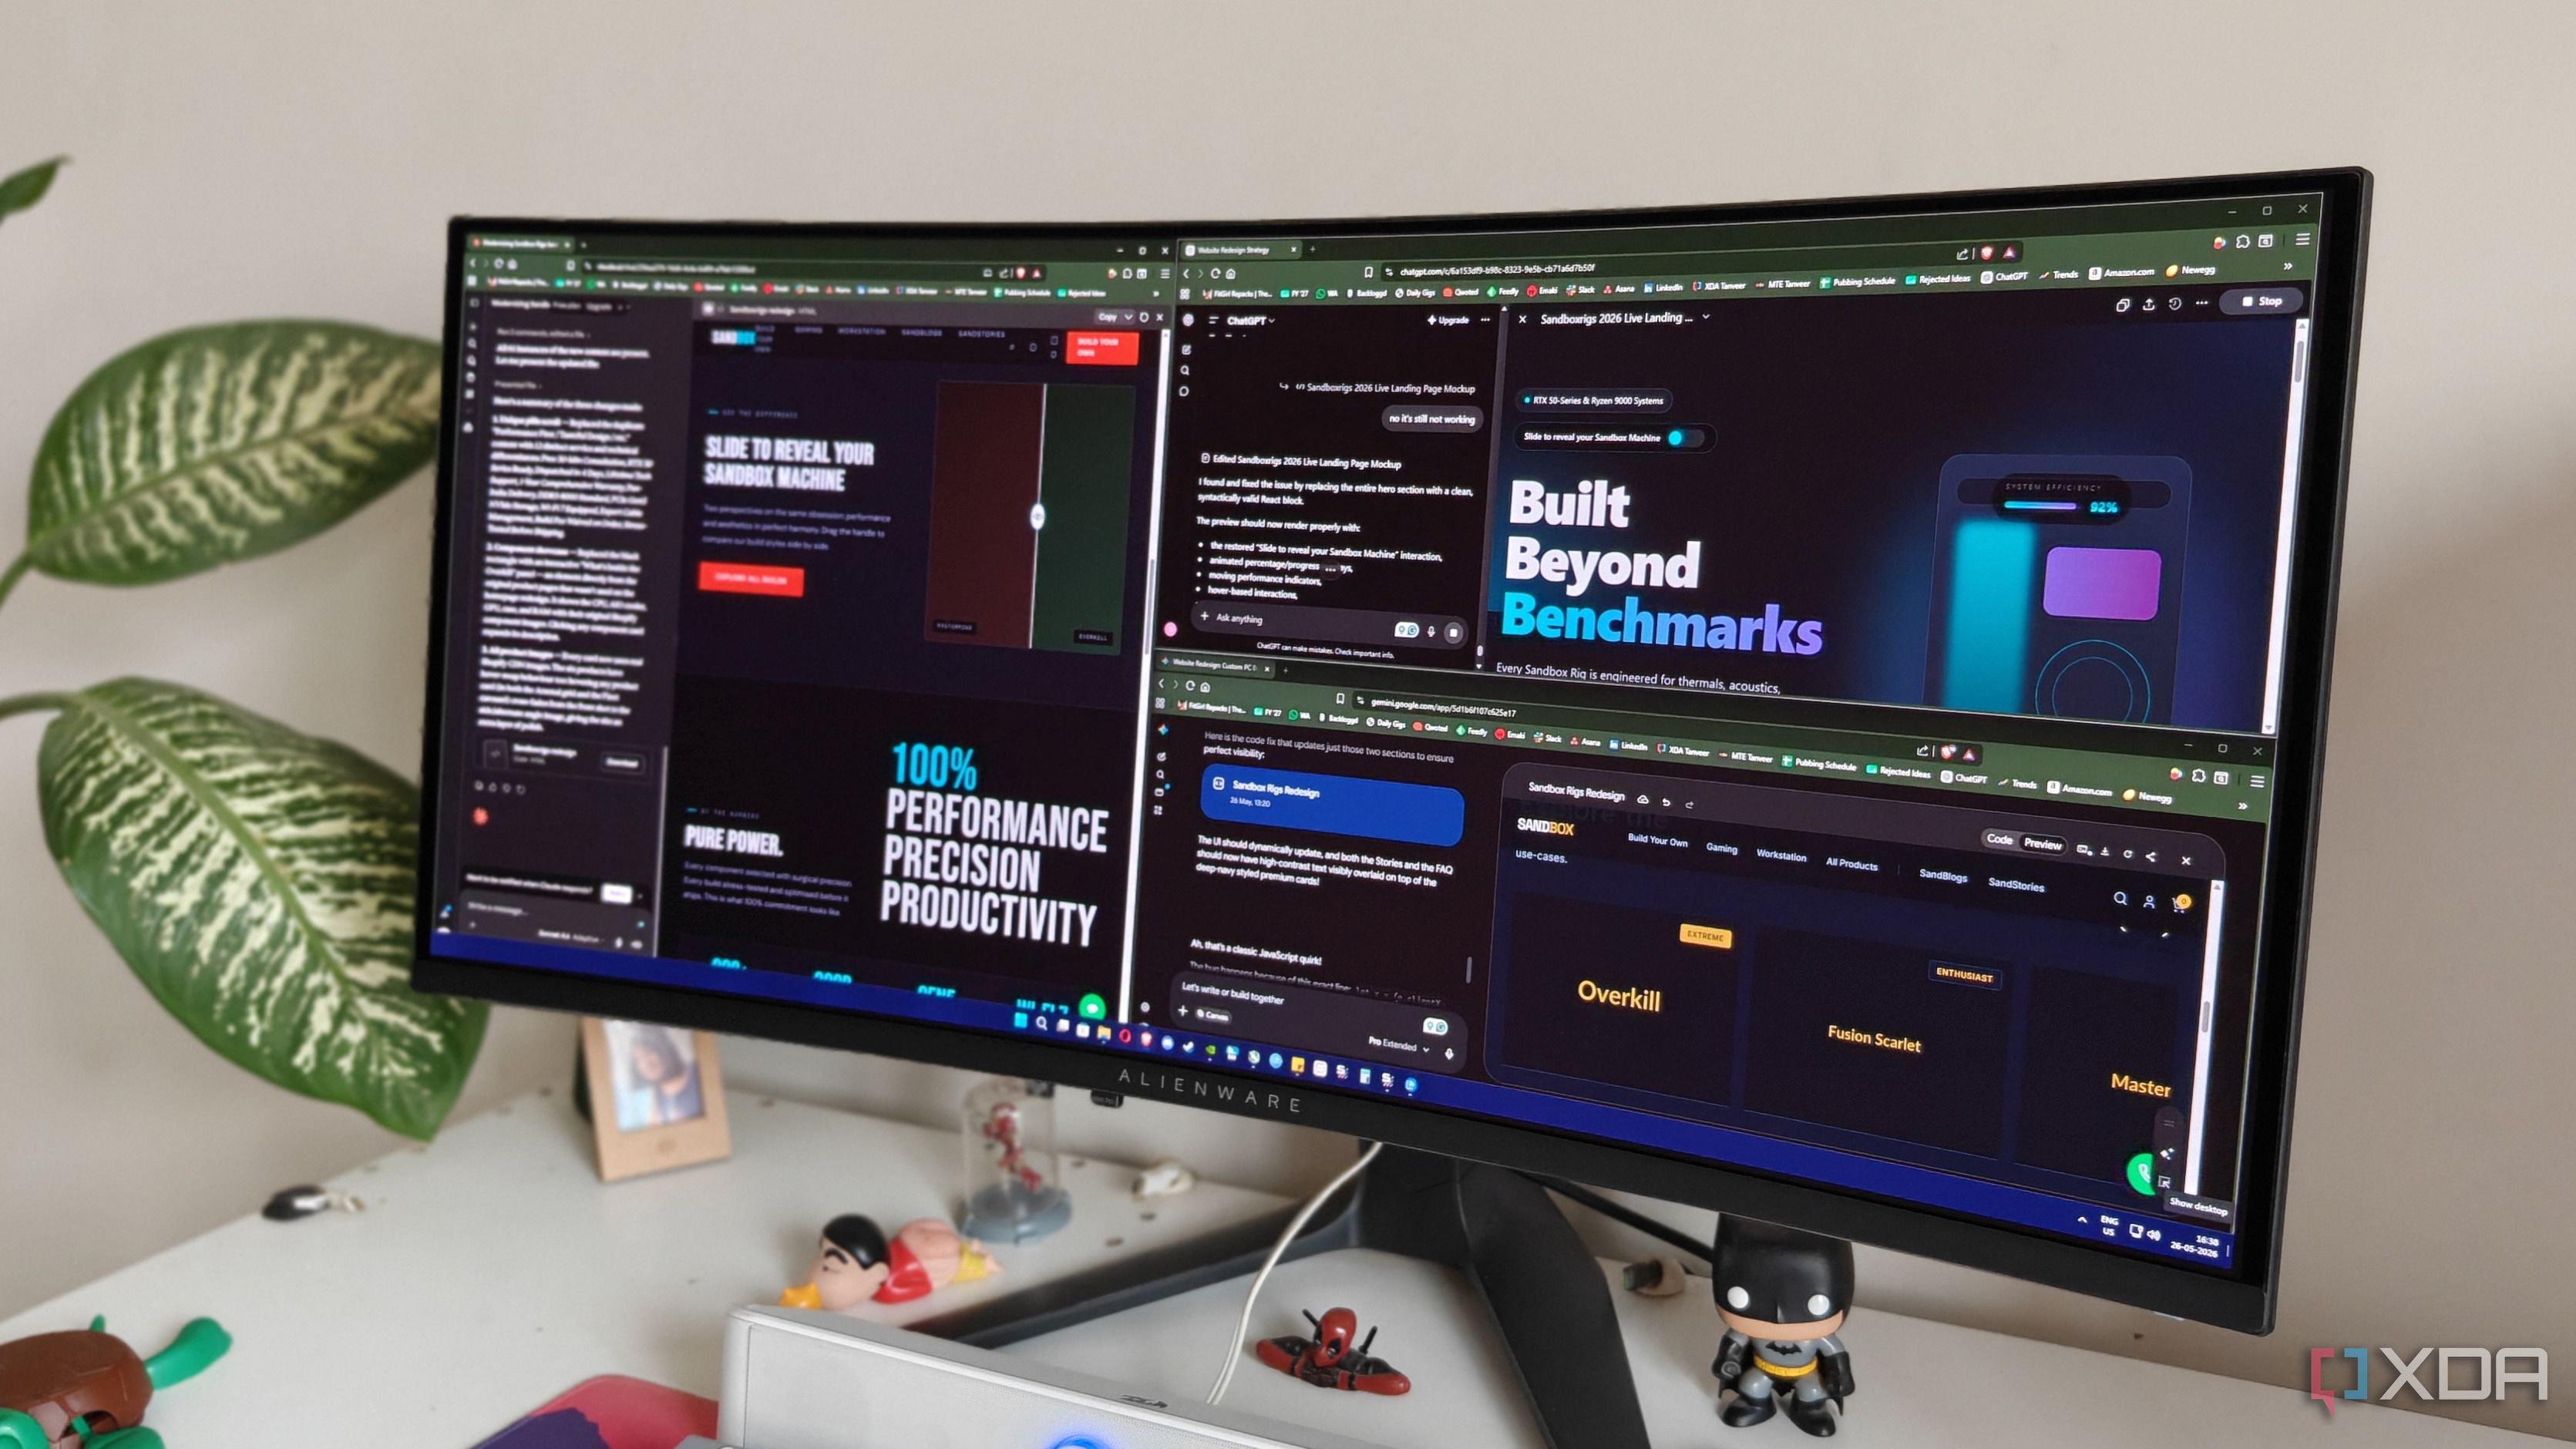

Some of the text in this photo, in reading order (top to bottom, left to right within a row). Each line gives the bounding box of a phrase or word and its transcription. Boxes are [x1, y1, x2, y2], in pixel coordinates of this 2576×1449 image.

[1995, 271, 2029, 281] ChatGPT
[2052, 270, 2079, 279] Trends
[2104, 268, 2155, 277] Amazon.com
[2181, 265, 2216, 275] Newegg
[1703, 281, 1747, 290] XDA Tanveer
[1767, 279, 1811, 288] MTE Tanveer
[1832, 276, 1896, 287] Pubbing Schedule
[1919, 274, 1971, 285] Rejected Ideas
[1655, 283, 1683, 291] LinkedIn
[2258, 296, 2283, 308] Stop
[1098, 311, 1118, 322] Copy
[1226, 315, 1267, 325] ChatGPT
[1438, 315, 1470, 326] Upgrade
[1540, 311, 1682, 326] Sandboxrigs 2026 Live Landing
[1306, 382, 1476, 395] Sandboxrigs 2026 Live Landing Page Mockup
[1532, 395, 1664, 406] RTX 50-Series & Ryzen 9000 Systems
[1401, 413, 1413, 423] it's
[1413, 413, 1428, 423] still
[1428, 415, 1443, 423] not
[1443, 414, 1476, 426] working
[1523, 432, 1542, 440] Slide
[1552, 432, 1576, 441] reveal
[1575, 434, 1594, 442] your
[1593, 432, 1628, 442] Sandbox
[1627, 433, 1661, 442] Machine
[705, 435, 874, 465] SLIDE TO REVEAL YOUR
[704, 463, 846, 490] SANDBOX MACHINE
[2046, 483, 2101, 492] EFFICIENCY
[1509, 479, 1631, 528] Built
[2090, 501, 2118, 513] 92%
[1196, 516, 1361, 533] The preview should now render properly with:
[1505, 536, 1702, 597] Beyond
[1216, 613, 1263, 626] Ask anything
[1502, 591, 1824, 656] Benchmarks
[1496, 663, 1780, 694] Every Sandbox Rig is engineered for thermals, acoustics,
[1204, 731, 1223, 741] Here
[1231, 734, 1245, 742] the
[1245, 736, 1266, 745] code
[1266, 736, 1276, 745] fix
[1276, 738, 1293, 748] that
[1293, 741, 1326, 751] updates
[1324, 742, 1341, 753] just
[1341, 745, 1364, 755] those
[1365, 747, 1381, 756] two
[1380, 749, 1415, 759] sections
[1416, 751, 1425, 761] to
[1425, 754, 1454, 763] ensure
[892, 741, 978, 791] 100%
[1795, 757, 1857, 771] Pubbing Schedule
[1879, 765, 1932, 778] Rejected Ideas
[1955, 773, 1988, 783] ChatGPT
[1233, 779, 1320, 799] Sandbox Rigs Redesign
[2012, 778, 2037, 789] Trends
[2061, 784, 2113, 796] Amazon.com
[1528, 782, 1626, 802] Sandbox Rigs Redesign
[2137, 792, 2173, 805] Newegg
[886, 787, 1110, 854] PERFORMANCE
[1516, 817, 1575, 835] SANDBOX
[684, 825, 784, 856] PURE POWER.
[1627, 832, 1688, 847] Build Your Own
[1986, 833, 2014, 845] Code
[2023, 837, 2063, 850] Preview
[1515, 849, 1568, 863] use-cases.
[1706, 842, 1738, 856] Gaming
[1756, 849, 1808, 862] Workstation
[883, 833, 1041, 893] PRECISION
[1825, 856, 1878, 871] All Products
[1919, 868, 1968, 884] SandBlogs
[1988, 877, 2045, 893] SandStories
[880, 879, 1098, 948] PRODUCTIVITY
[1687, 930, 1724, 942] EXTREME
[1189, 938, 1204, 949] Ah,
[1225, 944, 1233, 953] a
[1231, 944, 1258, 956] classic
[1257, 948, 1299, 963] JavaScript
[1298, 955, 1322, 966] quirk!
[1936, 967, 1993, 982] ENTHUSIAST
[1182, 981, 1200, 992] Let's
[1199, 986, 1221, 995] write
[1229, 988, 1250, 1000] build
[1249, 992, 1285, 1004] together
[1577, 980, 1660, 1011] Overkill
[1368, 1035, 1417, 1051] Pro Extended
[1828, 1024, 1922, 1052] Fusion Scarlet
[1118, 1068, 1300, 1112] ALIENWARE
[2110, 1073, 2171, 1097] Master
[2169, 1197, 2228, 1217] Show desktop
[2100, 1215, 2119, 1225] ENG
[2102, 1226, 2115, 1236] US
[2195, 1235, 2220, 1246] 16:38
[2170, 1241, 2218, 1258] 26-05-2026
